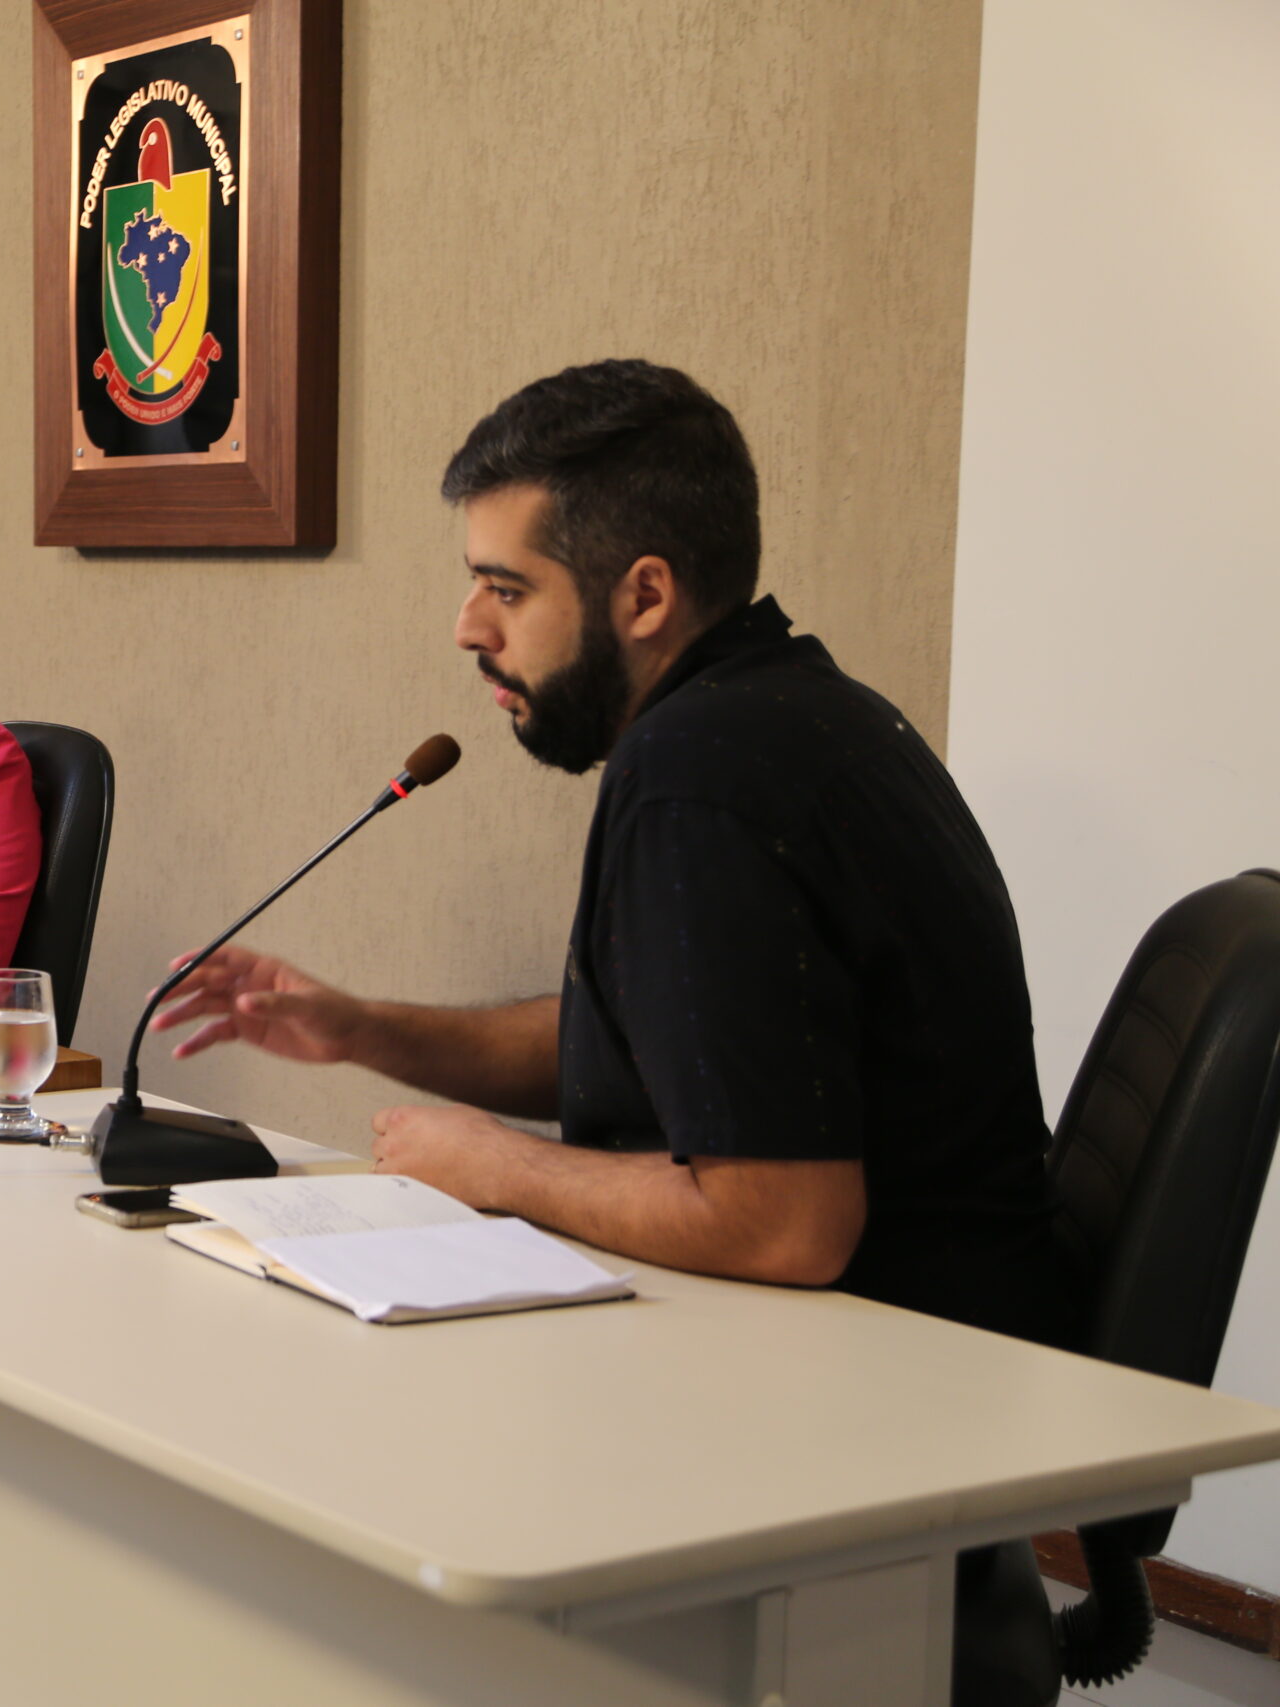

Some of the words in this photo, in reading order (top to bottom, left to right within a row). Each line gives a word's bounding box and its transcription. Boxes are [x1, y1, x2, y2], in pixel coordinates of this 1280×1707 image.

[80, 147, 112, 229] PODER
[104, 79, 189, 150] LEGISLATIVO
[186, 94, 237, 206] MUNICIPAL
